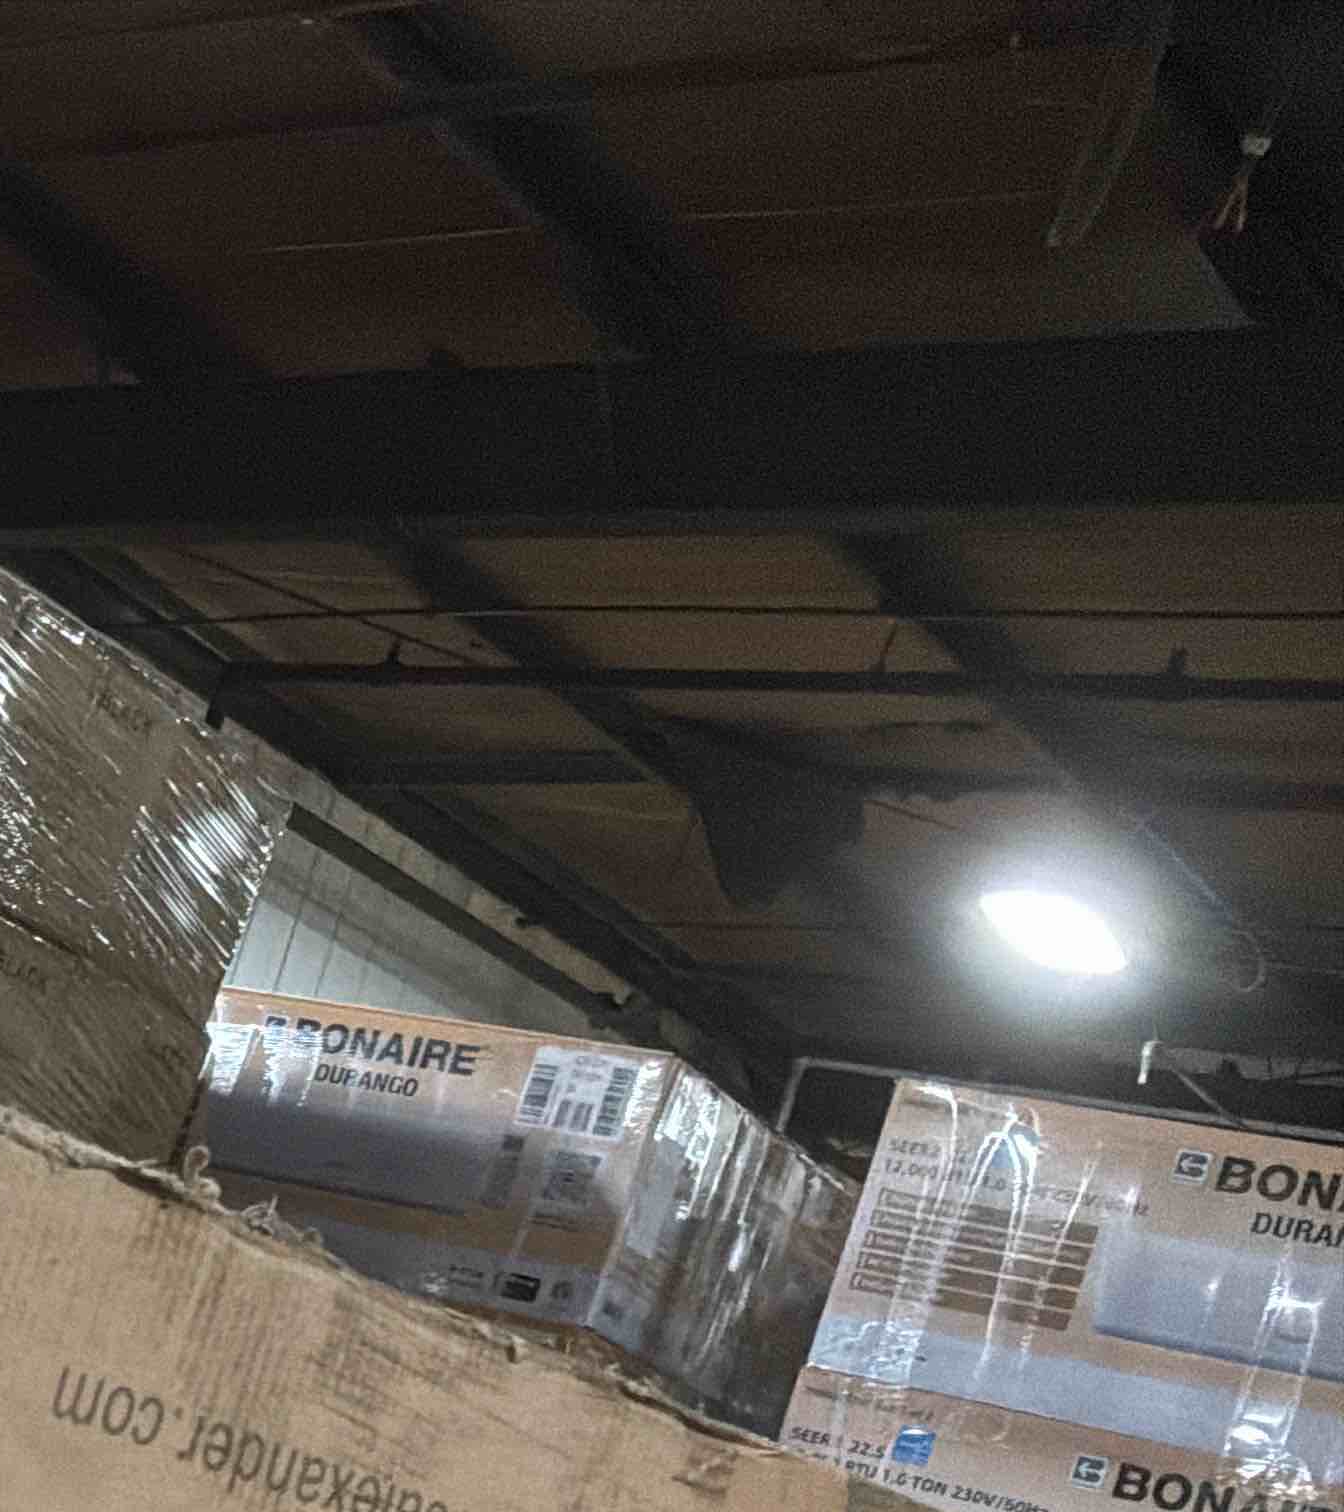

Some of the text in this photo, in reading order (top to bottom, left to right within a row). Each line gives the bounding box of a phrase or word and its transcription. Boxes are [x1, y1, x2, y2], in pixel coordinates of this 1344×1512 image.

[314, 1063, 419, 1097] DURANGO
[1215, 1156, 1344, 1212] BON
[912, 1475, 948, 1497] TON
